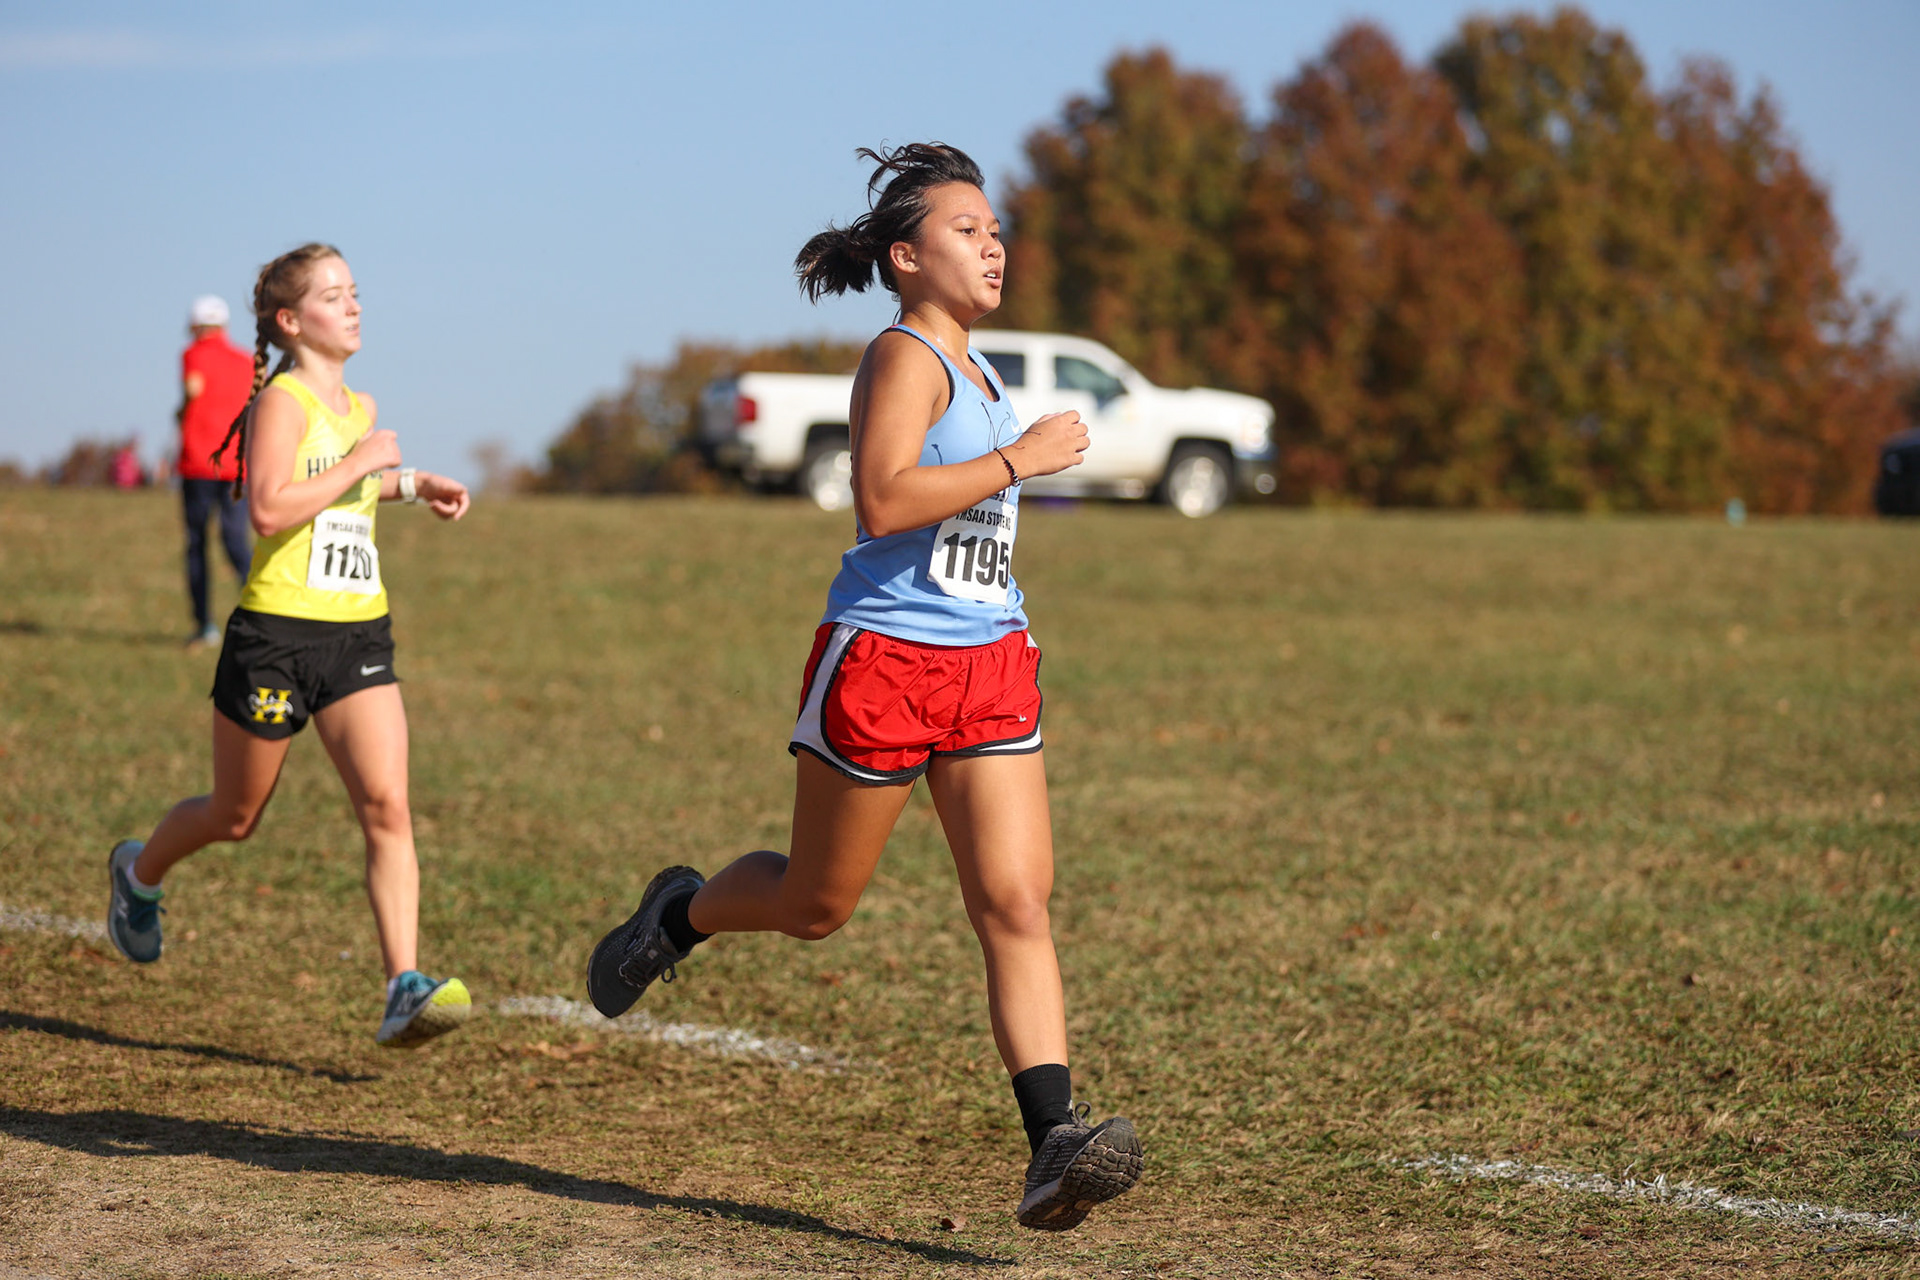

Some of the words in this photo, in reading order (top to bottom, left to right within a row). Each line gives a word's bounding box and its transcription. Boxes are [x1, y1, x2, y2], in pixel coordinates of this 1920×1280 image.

[986, 510, 1005, 529] STATE
[322, 542, 372, 580] 1120
[943, 532, 1010, 590] 1195
